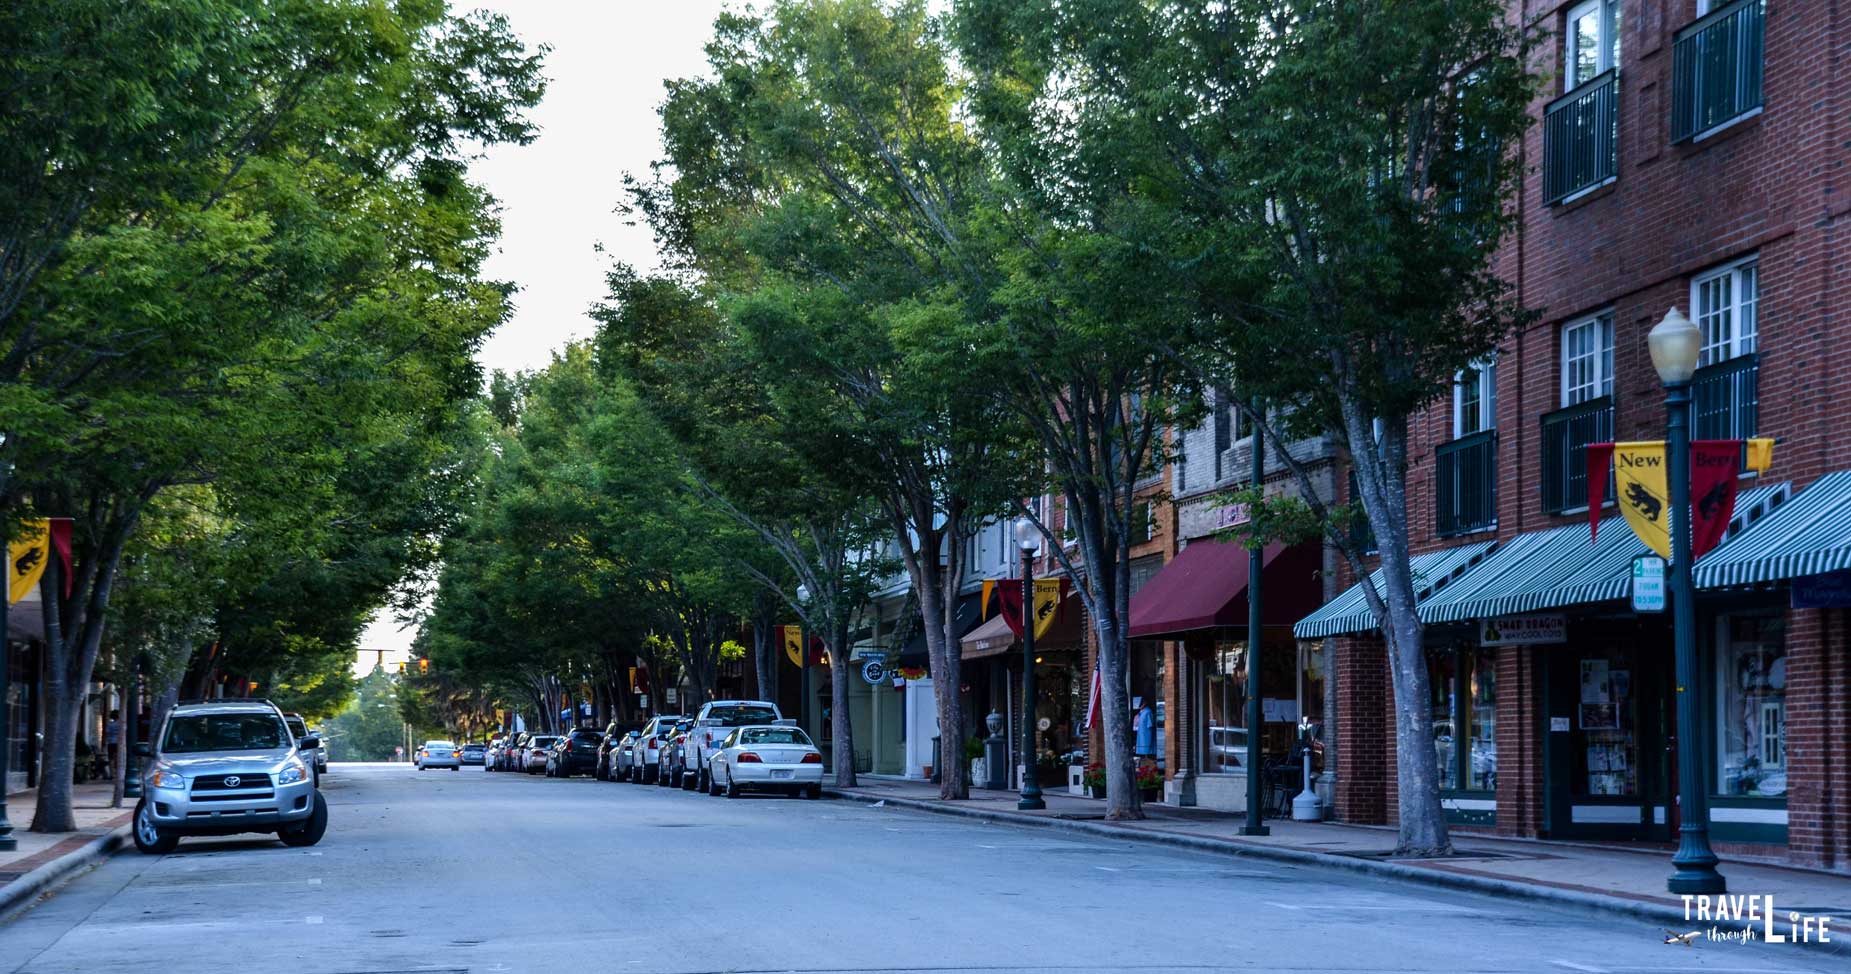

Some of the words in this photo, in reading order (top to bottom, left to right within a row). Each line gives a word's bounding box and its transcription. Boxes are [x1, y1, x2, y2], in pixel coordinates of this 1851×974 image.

[1619, 453, 1662, 468] New
[1633, 559, 1642, 575] 2
[1036, 585, 1058, 593] Bern
